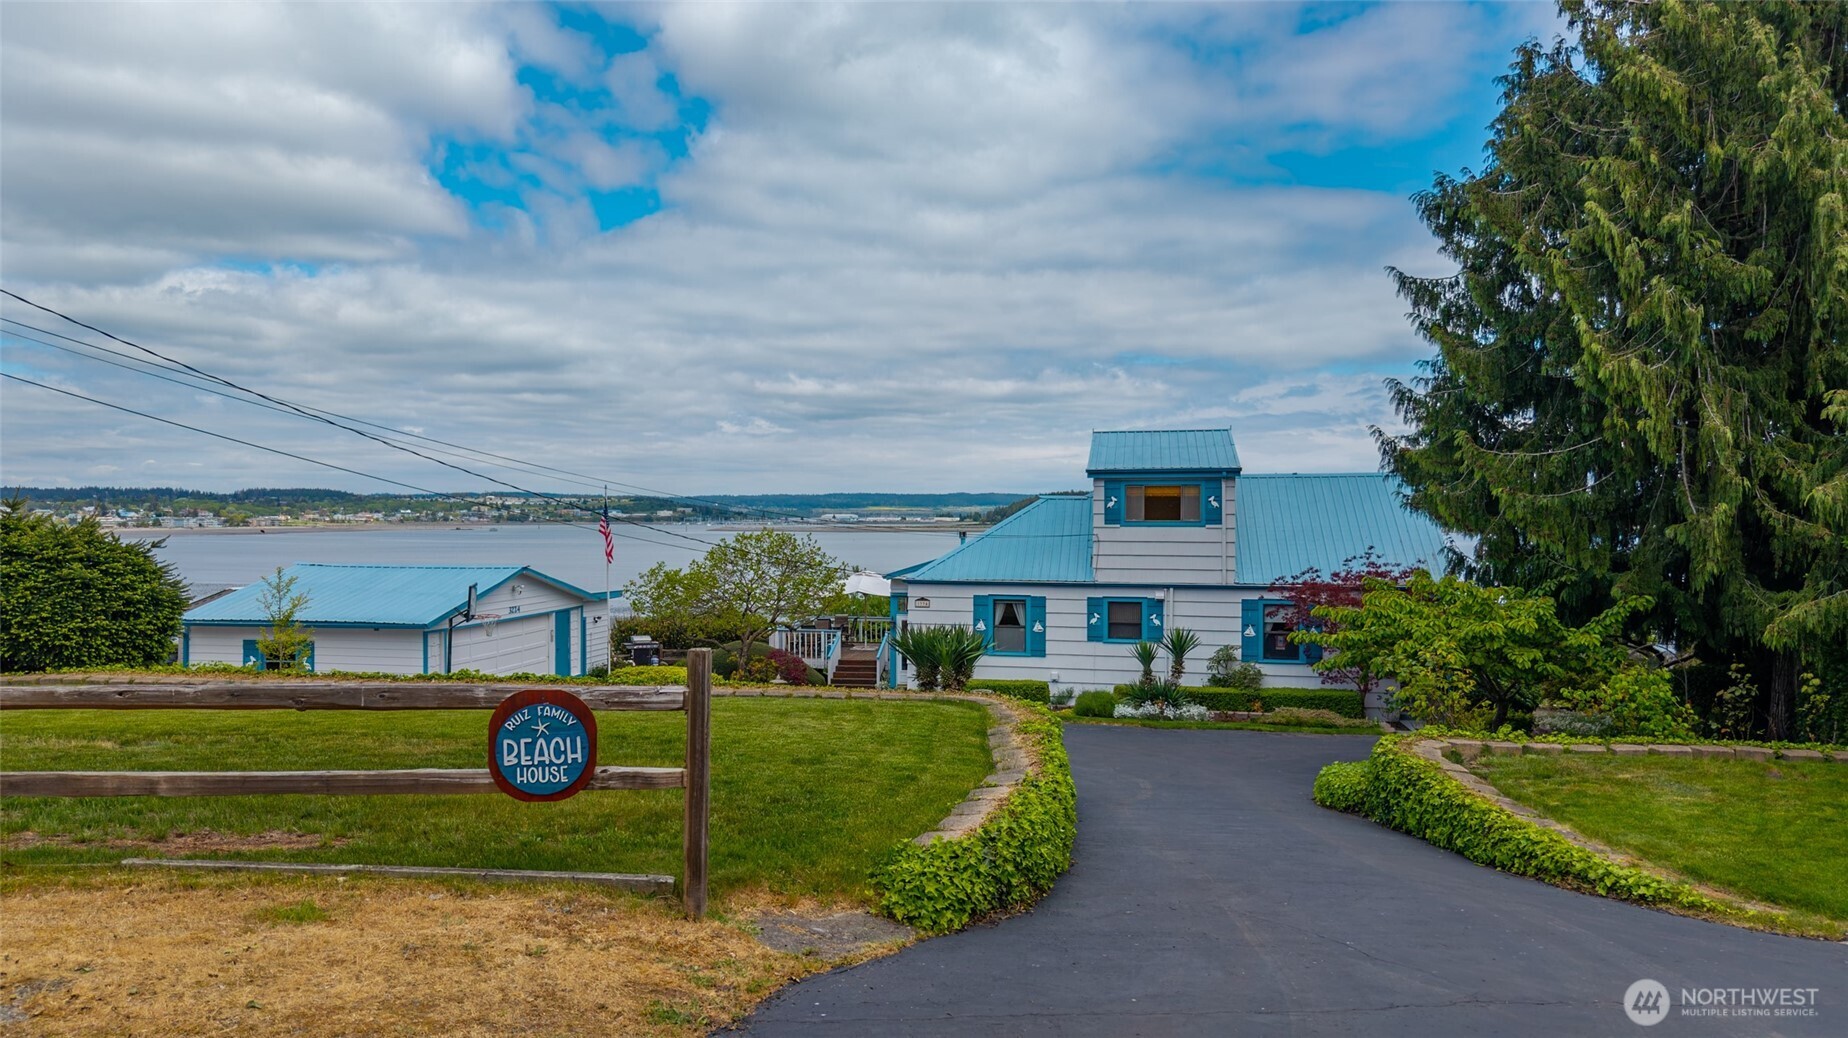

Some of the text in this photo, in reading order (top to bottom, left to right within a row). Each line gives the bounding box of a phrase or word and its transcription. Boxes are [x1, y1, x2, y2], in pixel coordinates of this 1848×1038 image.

[504, 705, 577, 731] RUIZ FAMILY
[503, 735, 582, 766] BEACH
[516, 765, 569, 784] HOUSE
